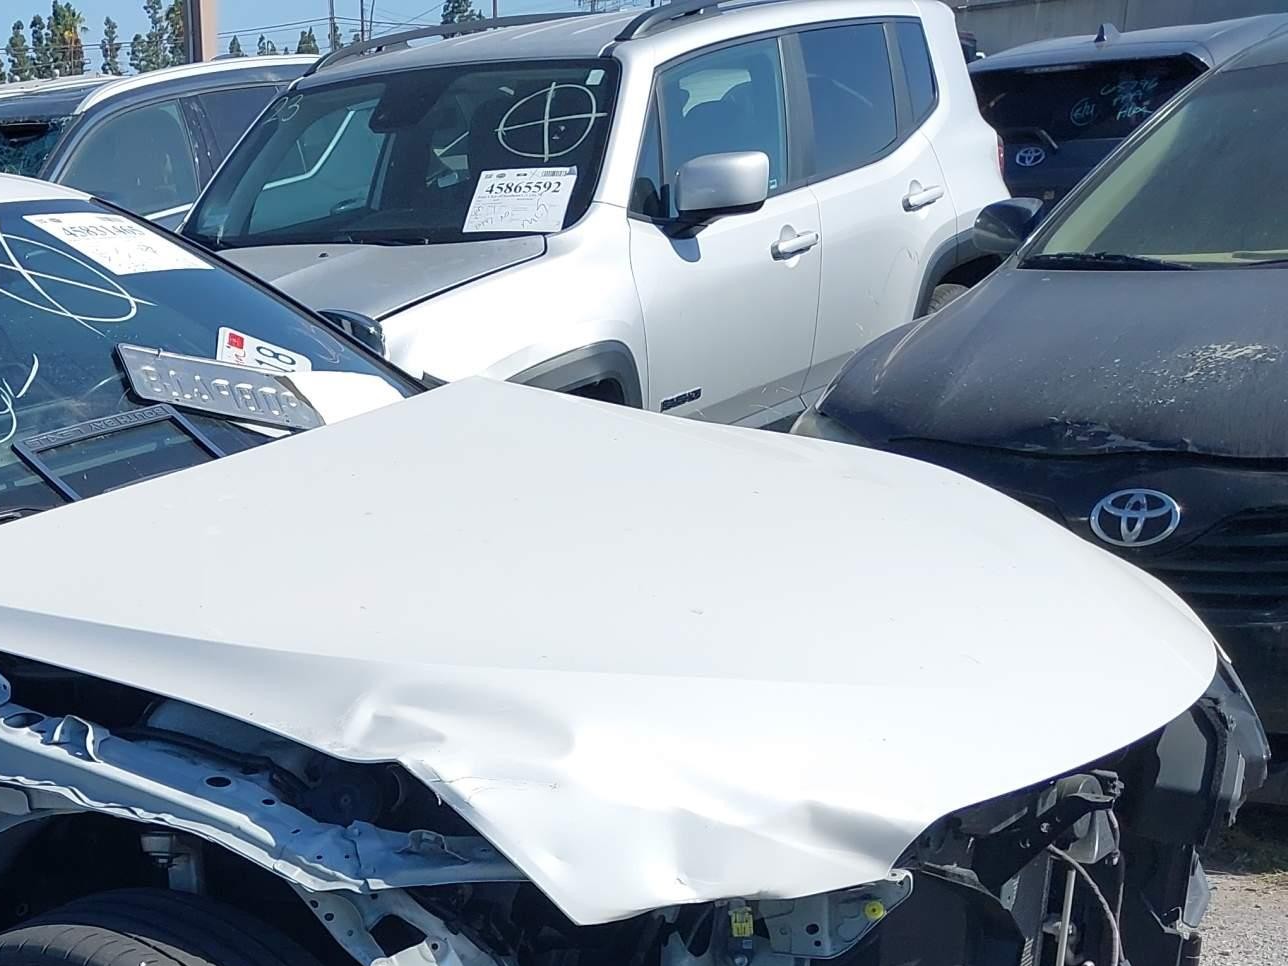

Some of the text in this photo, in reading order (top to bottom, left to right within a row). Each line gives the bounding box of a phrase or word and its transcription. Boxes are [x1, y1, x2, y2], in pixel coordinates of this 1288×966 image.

[485, 181, 562, 195] 45865592
[62, 224, 146, 239] 45831465
[89, 417, 118, 432] BAY
[117, 407, 165, 427] SOUTH
